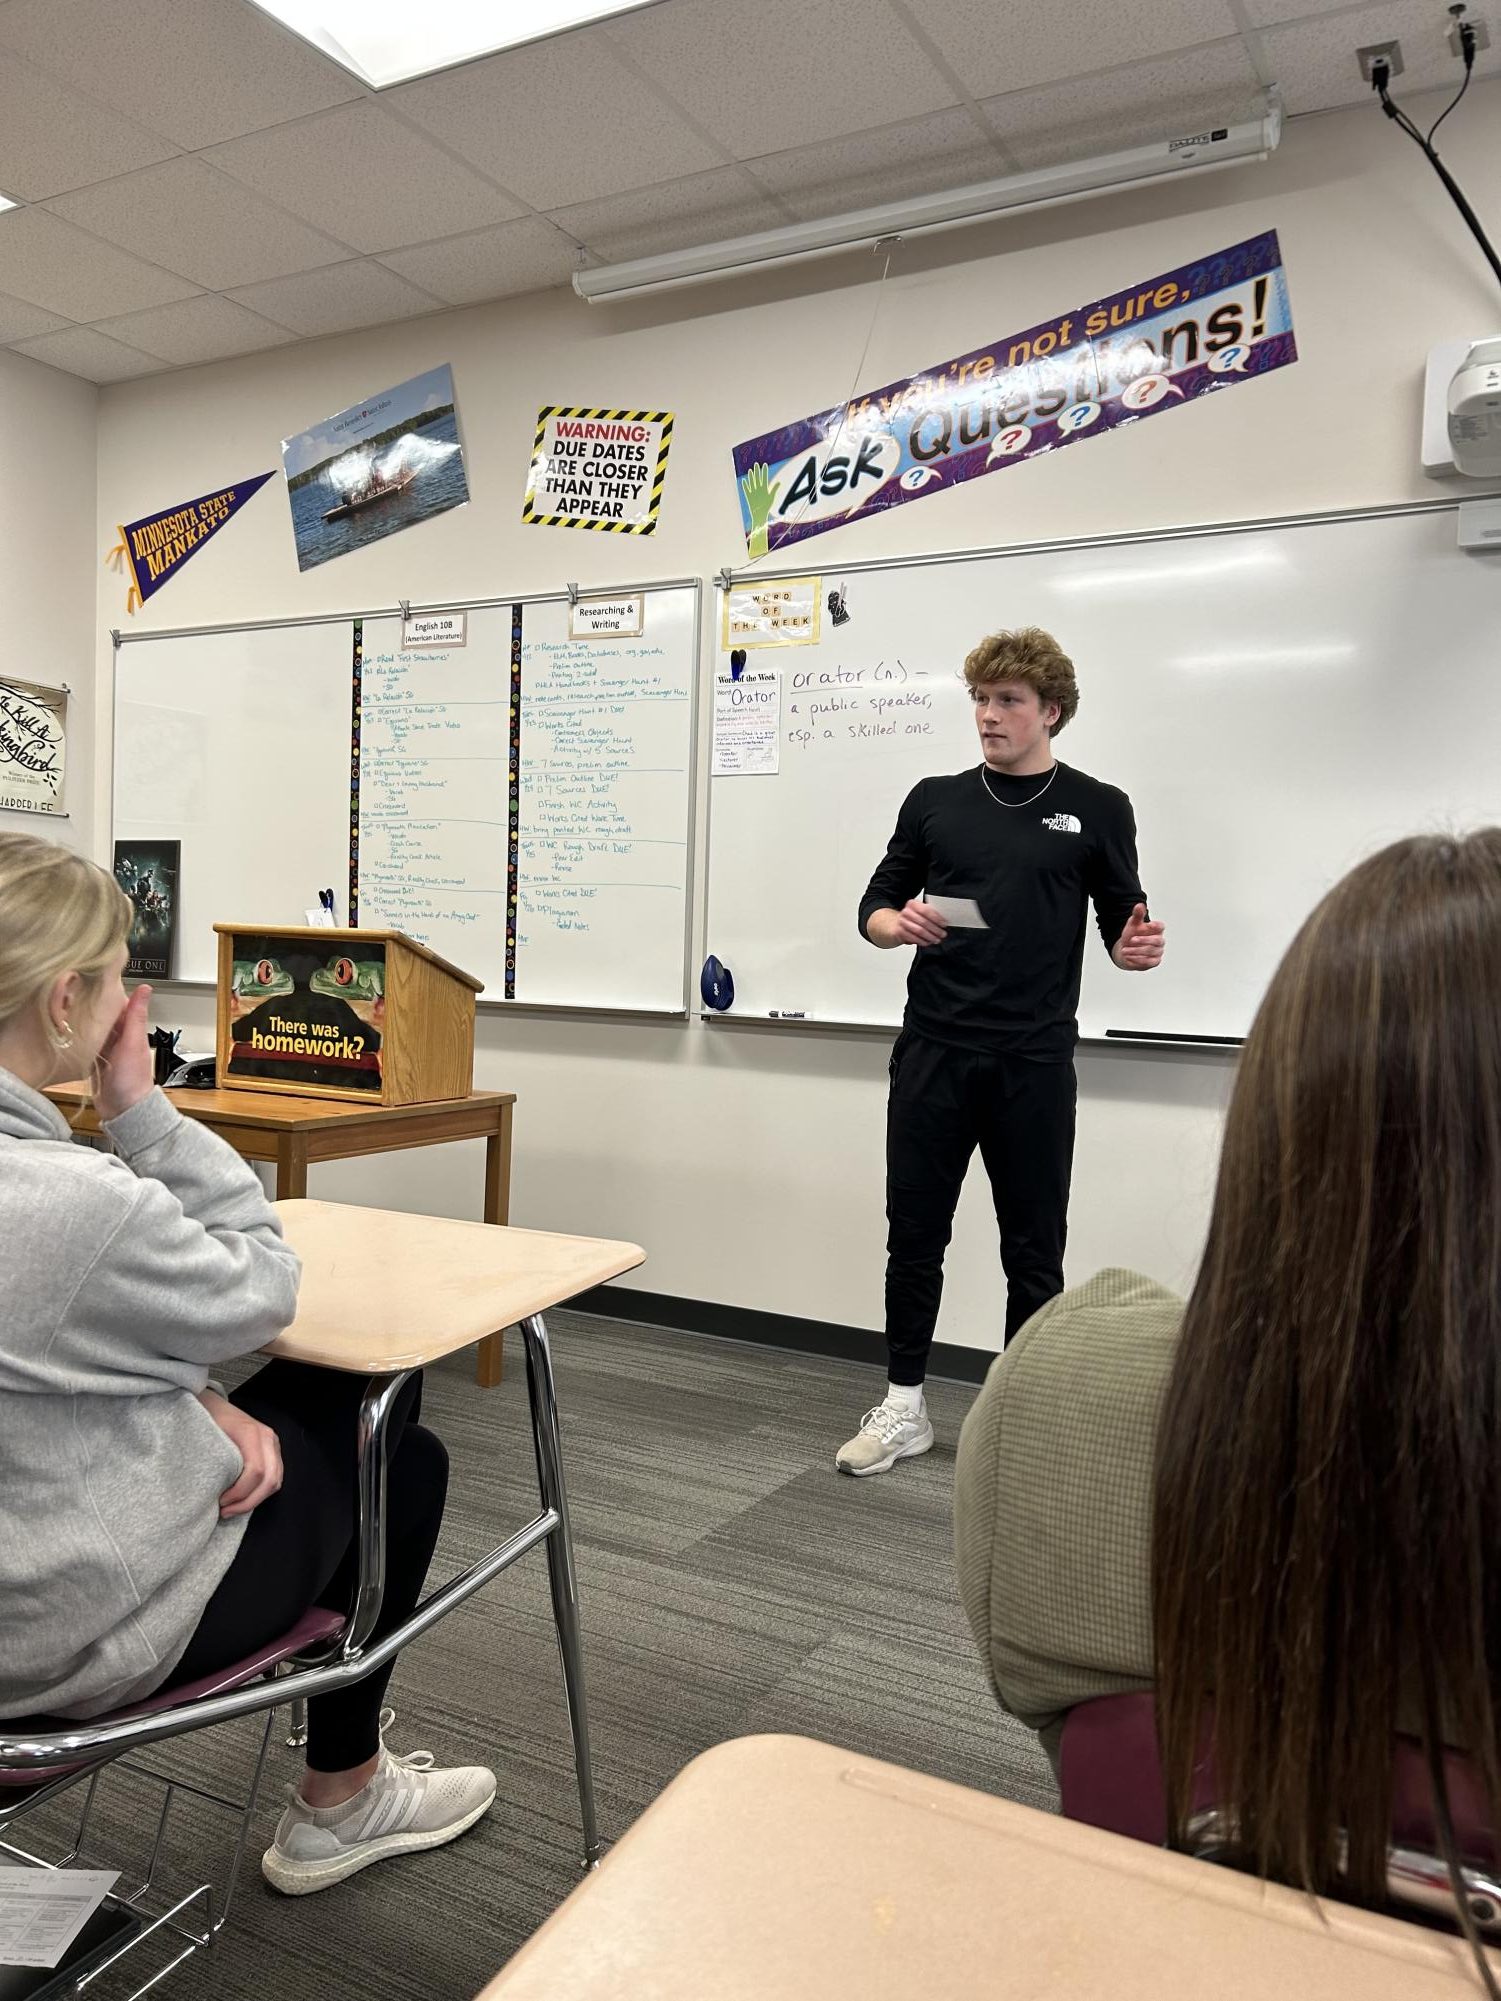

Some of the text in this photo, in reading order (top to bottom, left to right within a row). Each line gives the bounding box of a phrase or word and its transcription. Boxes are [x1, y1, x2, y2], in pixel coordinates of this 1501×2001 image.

[1008, 319, 1073, 368] not
[1085, 282, 1191, 336] sure,
[556, 421, 651, 443] WARNING:
[553, 440, 645, 461] DUE DATES
[545, 458, 648, 481] ARE CLOSER
[778, 436, 884, 515] Ask
[545, 477, 643, 500] THAN THEY
[556, 497, 624, 518] APPEAR
[132, 491, 236, 560] MINNESOTA STATE
[146, 506, 231, 581] MANKATO
[579, 604, 634, 617] Researching &
[415, 622, 439, 633] English
[591, 620, 620, 630] Writing
[772, 617, 808, 627] WEEK
[405, 632, 462, 644] (American Literature)
[746, 674, 757, 682] the
[757, 672, 776, 681] Week
[792, 660, 908, 688] orator (n.)
[731, 688, 776, 705] Orator
[11, 705, 40, 732] Kill
[791, 692, 932, 726] a public speaker,
[788, 729, 816, 750] esp.
[823, 728, 835, 739] a
[904, 722, 934, 735] one
[1042, 817, 1069, 827] NORTH
[1054, 812, 1069, 820] THE
[1048, 823, 1069, 832] FACE
[145, 960, 163, 970] ONE
[269, 1016, 339, 1038] There was
[251, 1028, 364, 1060] homework?
